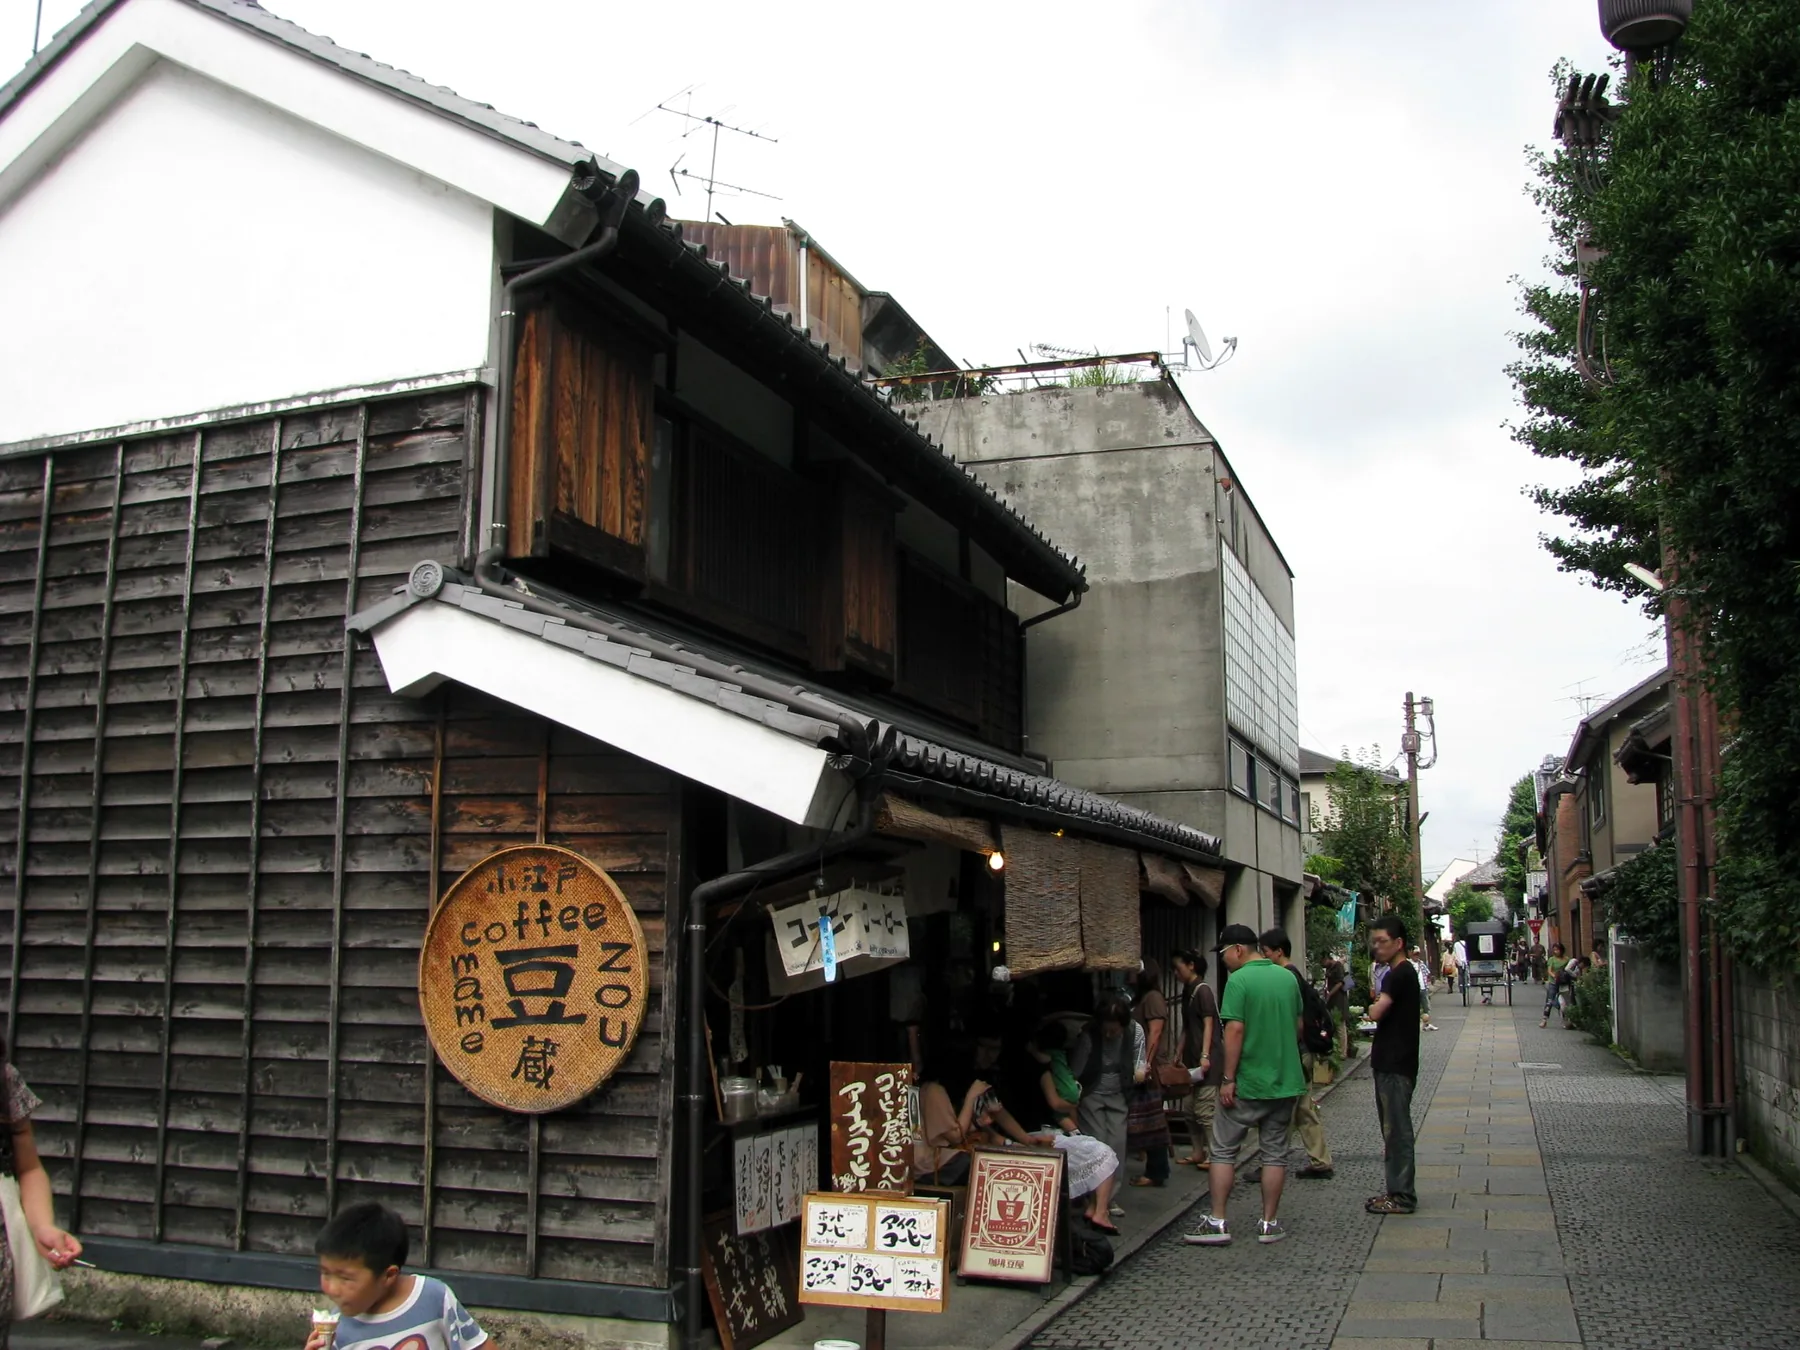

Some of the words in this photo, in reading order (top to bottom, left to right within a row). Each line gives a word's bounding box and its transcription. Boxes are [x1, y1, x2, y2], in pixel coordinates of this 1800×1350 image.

[487, 861, 578, 894] 小江戸
[460, 899, 608, 947] coffee
[451, 951, 485, 1054] mame
[839, 1081, 873, 1192] アイスコーヒー
[818, 1208, 844, 1222] ホット
[880, 1213, 917, 1230] アイス
[816, 1222, 854, 1238] コーヒー
[882, 1229, 932, 1247] コーヒー
[807, 1255, 846, 1271] マンゴー
[851, 1275, 892, 1291] コーヒー
